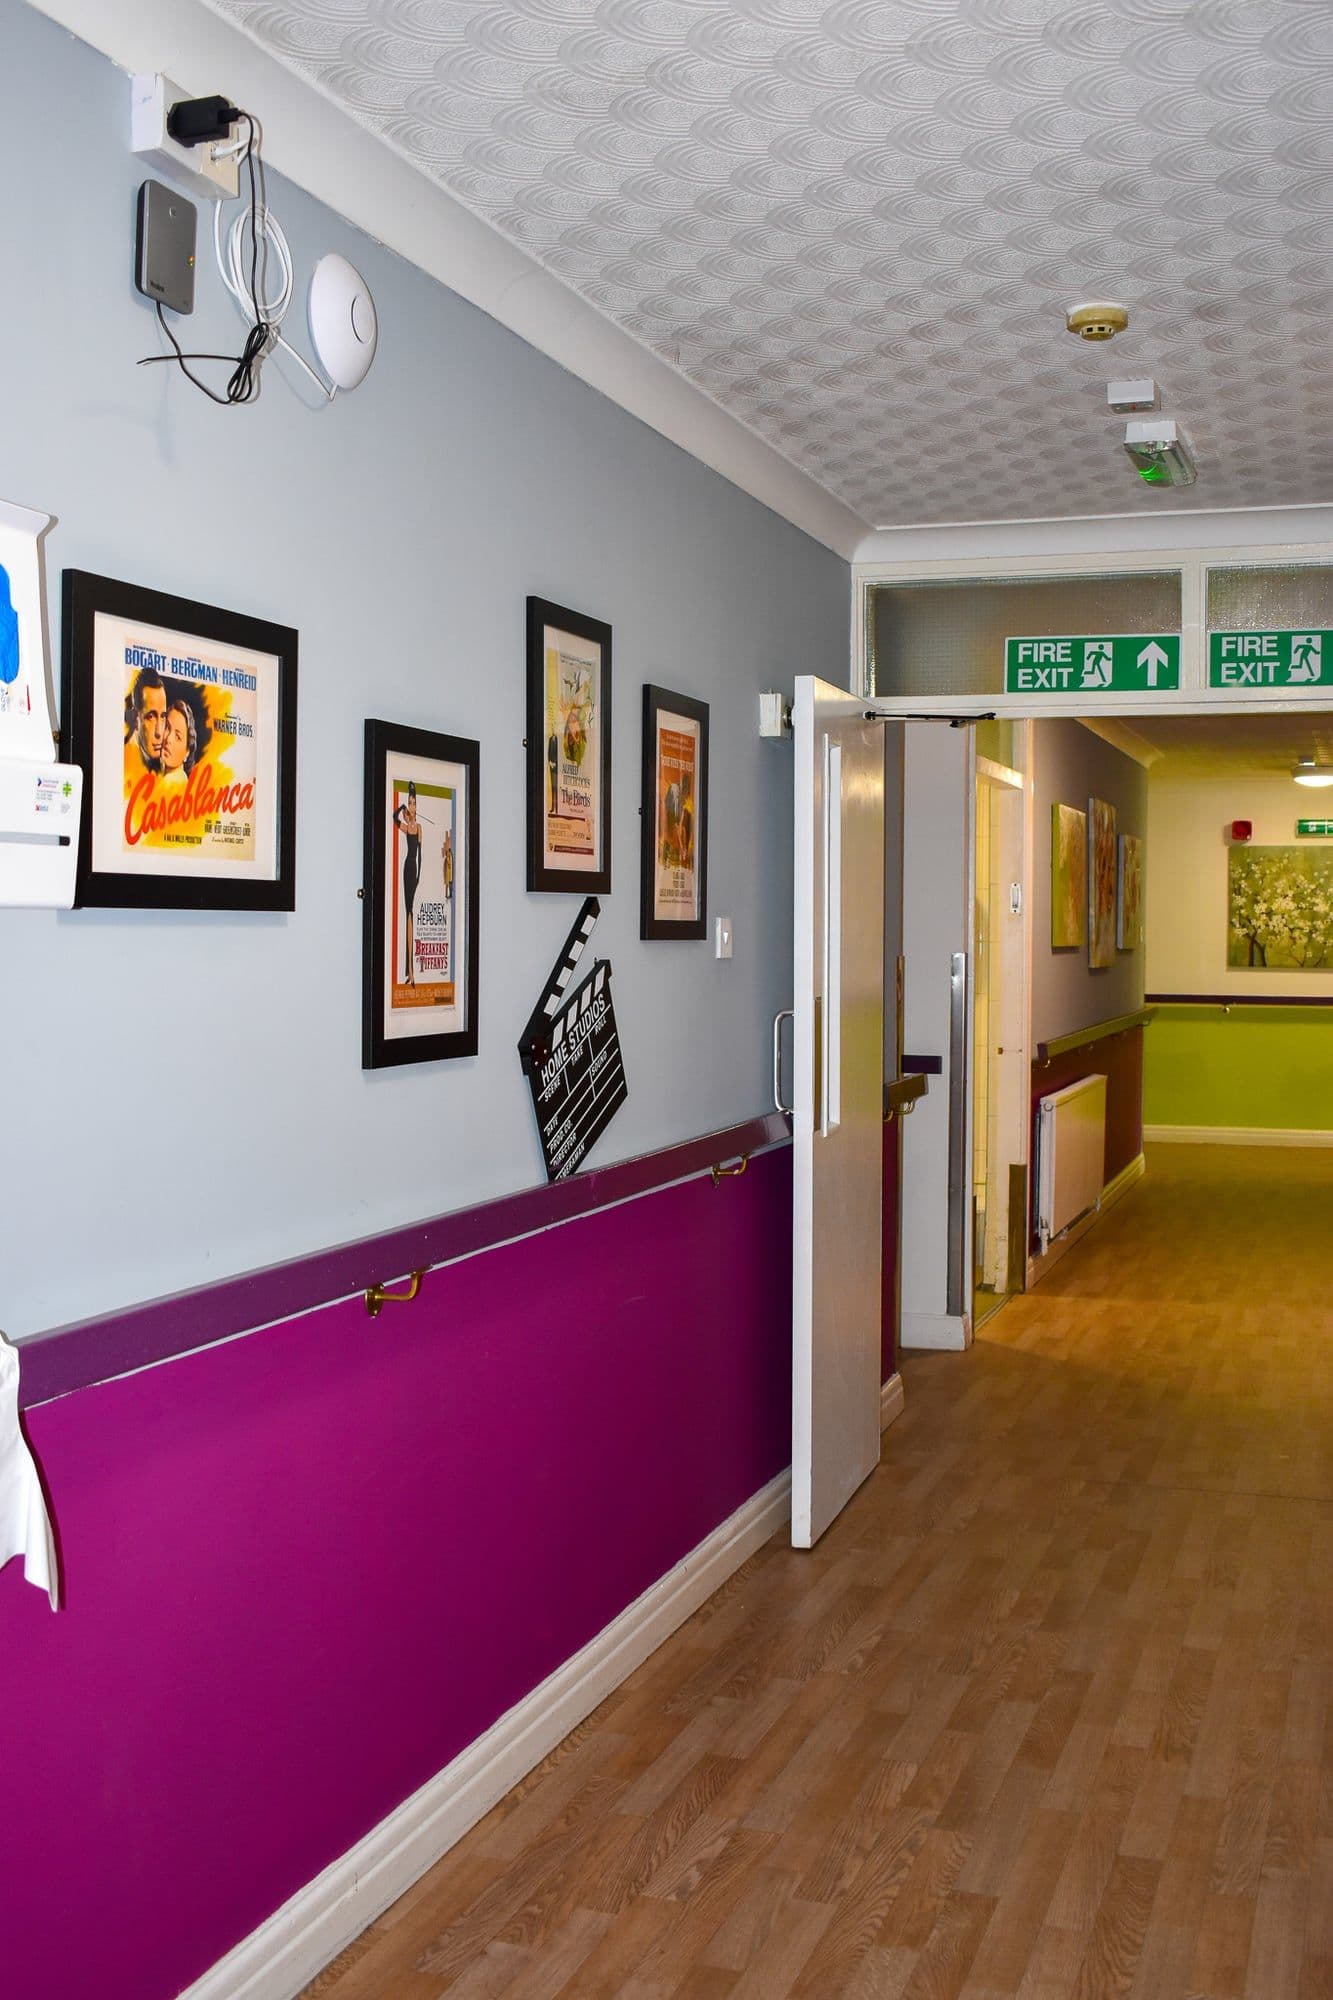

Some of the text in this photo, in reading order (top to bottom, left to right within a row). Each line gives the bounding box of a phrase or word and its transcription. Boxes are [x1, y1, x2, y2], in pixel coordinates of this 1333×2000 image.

[1017, 642, 1072, 663] FIRE
[1221, 636, 1278, 657] FIRE
[125, 648, 257, 691] BOGART BERGMAN HENREID
[1017, 667, 1074, 689] EXIT
[1220, 661, 1281, 683] EXIT
[213, 718, 237, 735] WARNER
[125, 763, 255, 845] Casablanca
[420, 902, 445, 914] AUDREY
[417, 913, 447, 926] HEPBURN
[415, 939, 449, 956] BREAKFAST
[595, 1016, 607, 1035] ROLL
[541, 993, 605, 1087] HOME STUDIOS
[571, 1045, 584, 1066] TAKE
[591, 1050, 608, 1076] SOUND
[544, 1075, 561, 1102] SCENE
[553, 1132, 577, 1166] DIRECTOR
